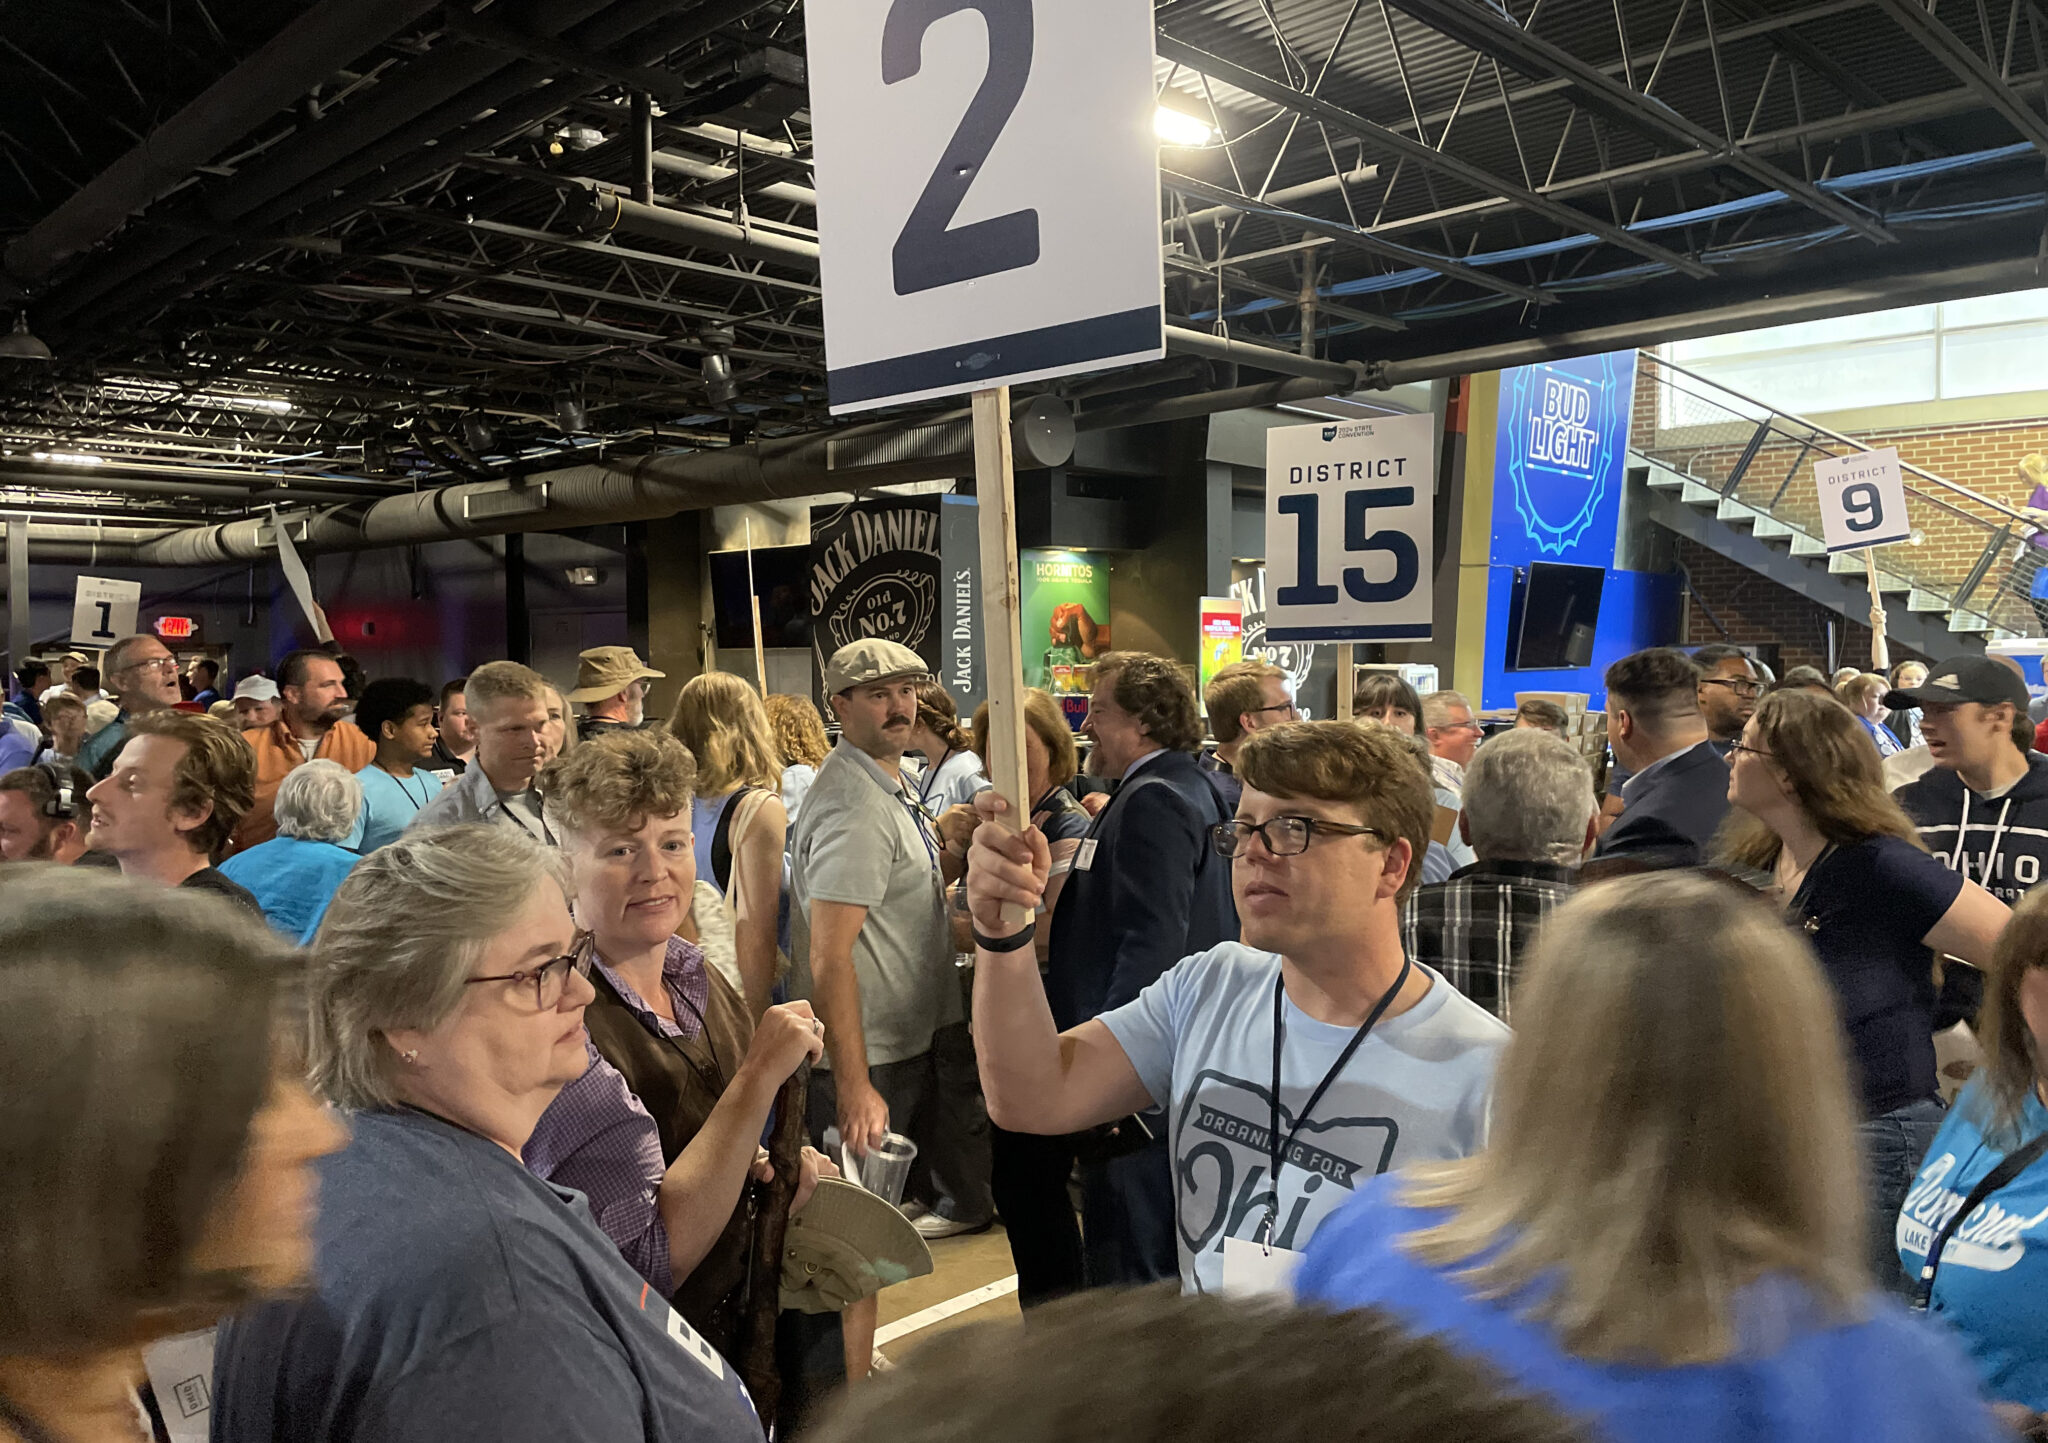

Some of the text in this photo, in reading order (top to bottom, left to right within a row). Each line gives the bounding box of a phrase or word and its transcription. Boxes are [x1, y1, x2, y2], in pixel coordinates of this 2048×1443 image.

[881, 0, 1040, 296] 2
[1543, 378, 1590, 427] BUD
[1529, 416, 1596, 469] LIGHT
[1290, 458, 1407, 484] DISTRICT
[1828, 465, 1887, 485] DISTRICT
[1842, 482, 1884, 533] 9
[811, 508, 942, 616] JACK DANIEL
[1277, 486, 1419, 606] 15
[1036, 562, 1093, 578] HORNITOS
[92, 601, 116, 638] 1
[867, 590, 892, 610] Old
[953, 645, 972, 693] JACK
[1066, 699, 1088, 713] Bull
[1309, 1154, 1348, 1180] FOR
[1177, 1141, 1323, 1254] Ohi
[1904, 1228, 1929, 1250] LAKE
